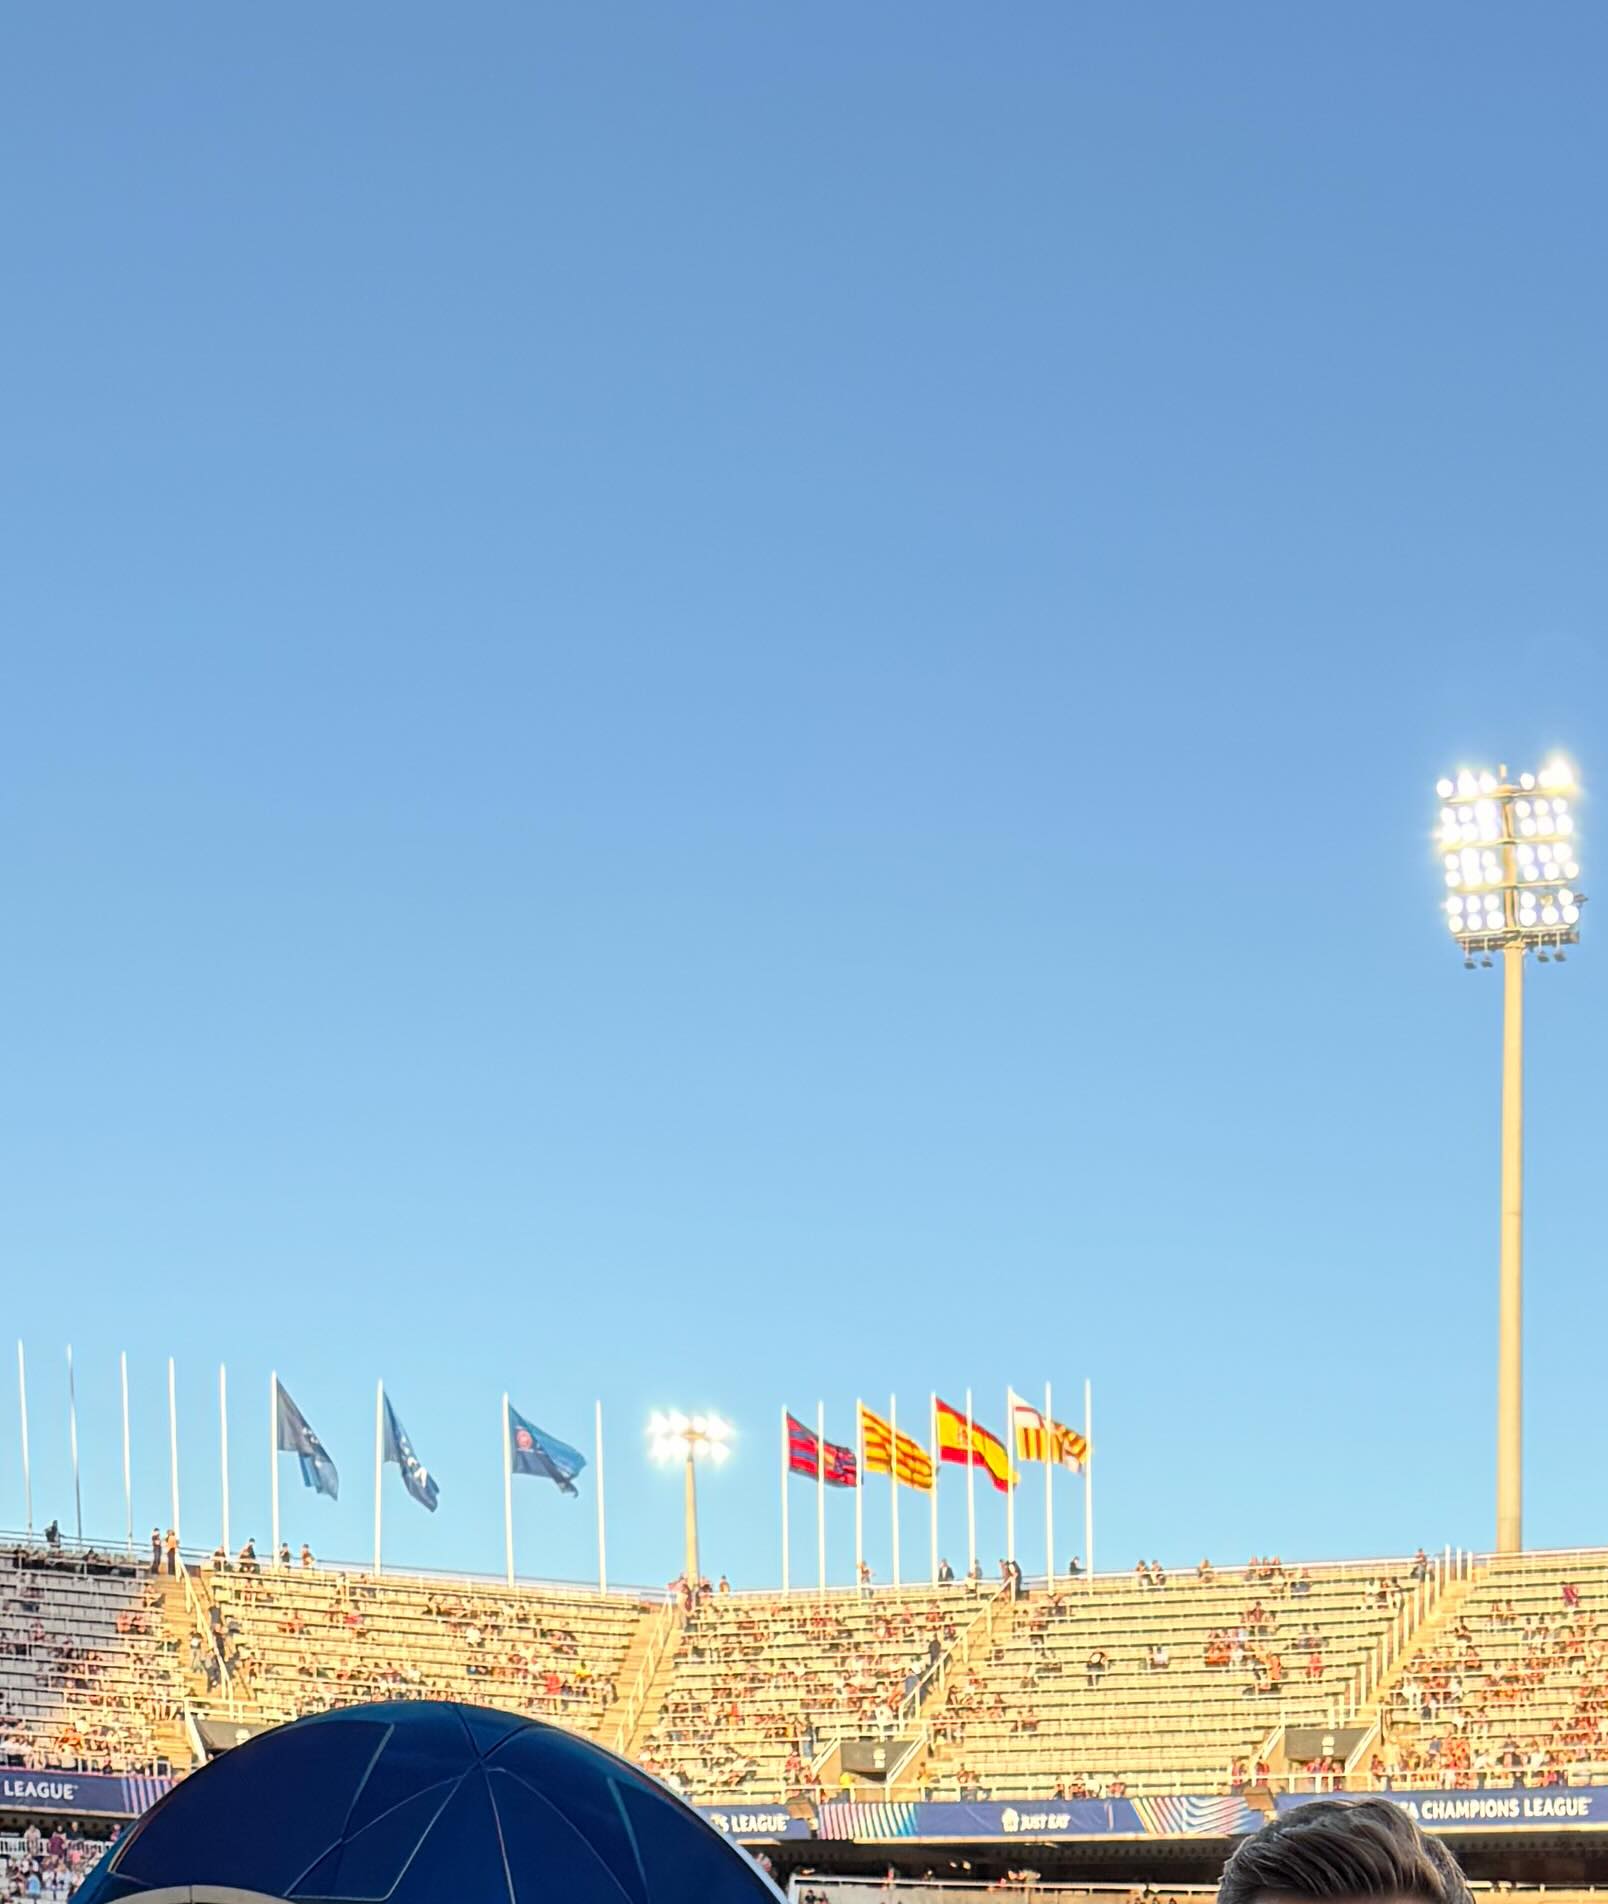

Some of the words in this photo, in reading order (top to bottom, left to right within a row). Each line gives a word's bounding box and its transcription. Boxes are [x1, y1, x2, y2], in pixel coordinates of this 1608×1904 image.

[4, 1780, 74, 1800] LEAGUE
[1421, 1799, 1520, 1819] CHAMPIONS
[1523, 1797, 1590, 1817] LEAGUE
[731, 1814, 787, 1832] LEAGUE
